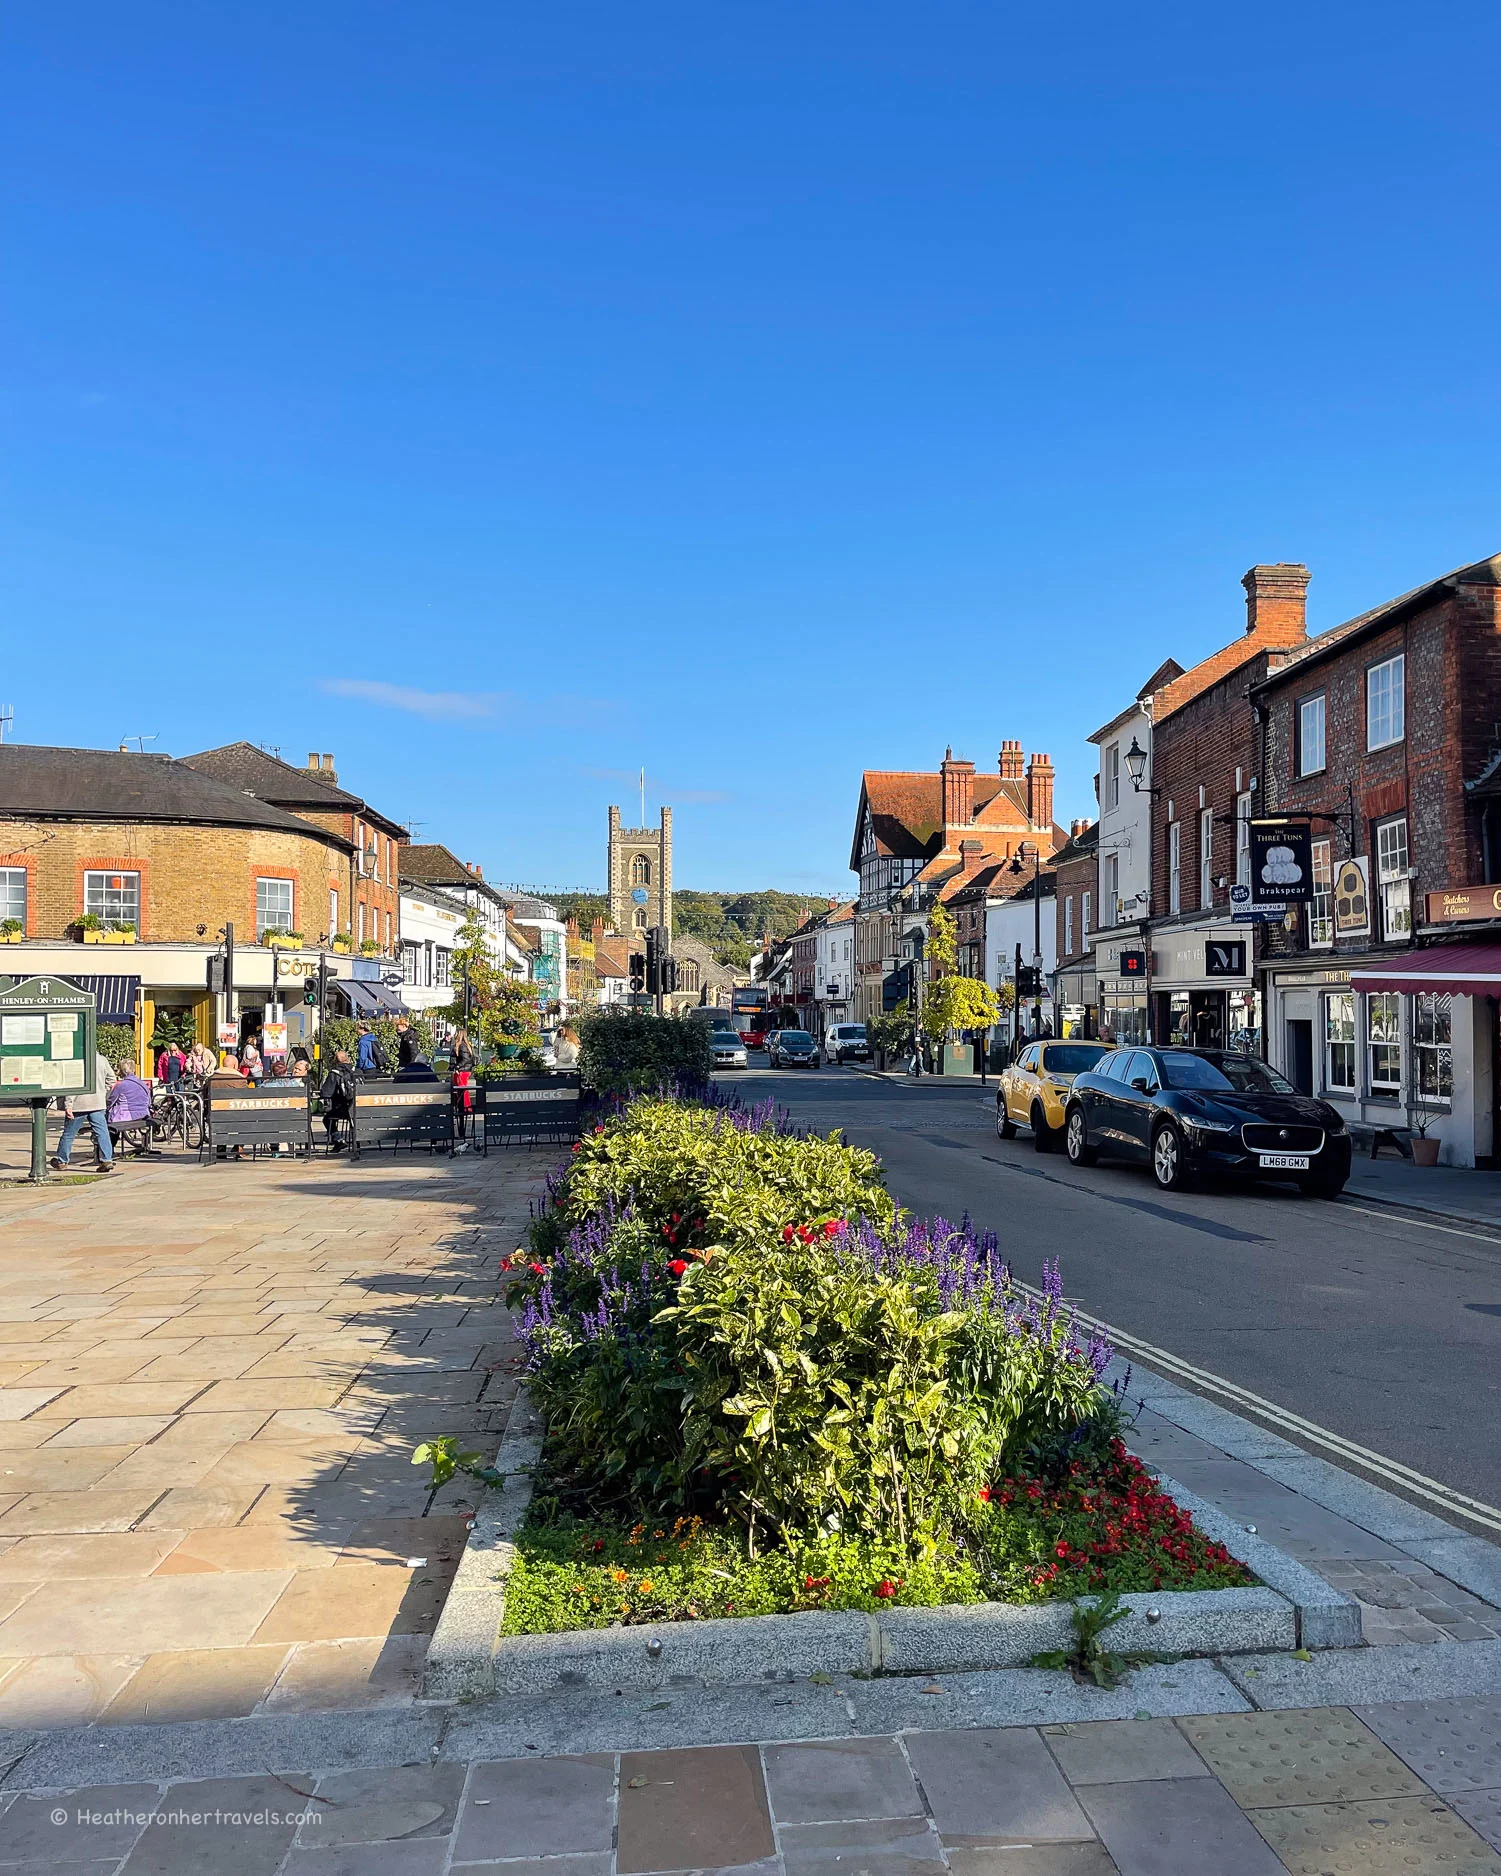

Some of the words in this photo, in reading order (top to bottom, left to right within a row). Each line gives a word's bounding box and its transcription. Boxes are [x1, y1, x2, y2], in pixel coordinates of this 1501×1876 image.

[1256, 834, 1280, 842] THREE
[1259, 887, 1306, 895] Brakspear
[1443, 894, 1470, 905] Butchers
[1443, 905, 1450, 916] &
[1325, 971, 1339, 982] THE
[1339, 970, 1352, 981] TH
[373, 1095, 434, 1104] STARBUCKS
[503, 1091, 563, 1100] STARBUCKS
[229, 1099, 291, 1109] STARBUCKS
